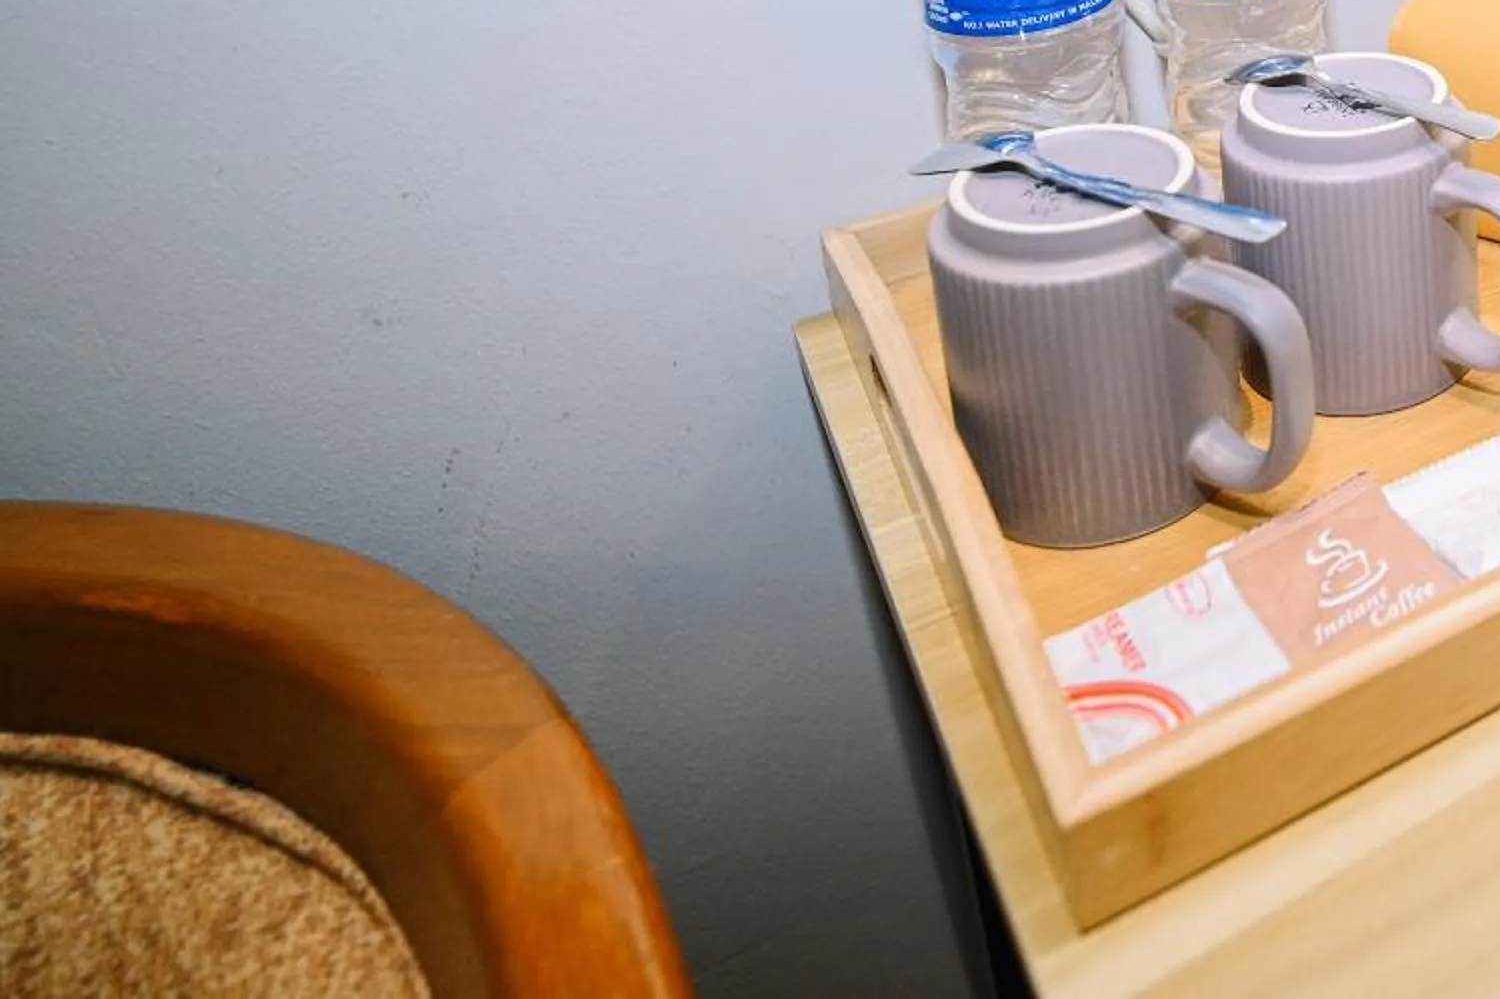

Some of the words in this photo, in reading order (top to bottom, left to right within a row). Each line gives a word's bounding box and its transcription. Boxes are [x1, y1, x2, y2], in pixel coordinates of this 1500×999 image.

[985, 20, 1019, 29] WATER
[1311, 585, 1388, 648] Instant
[1369, 581, 1436, 628] Coffee
